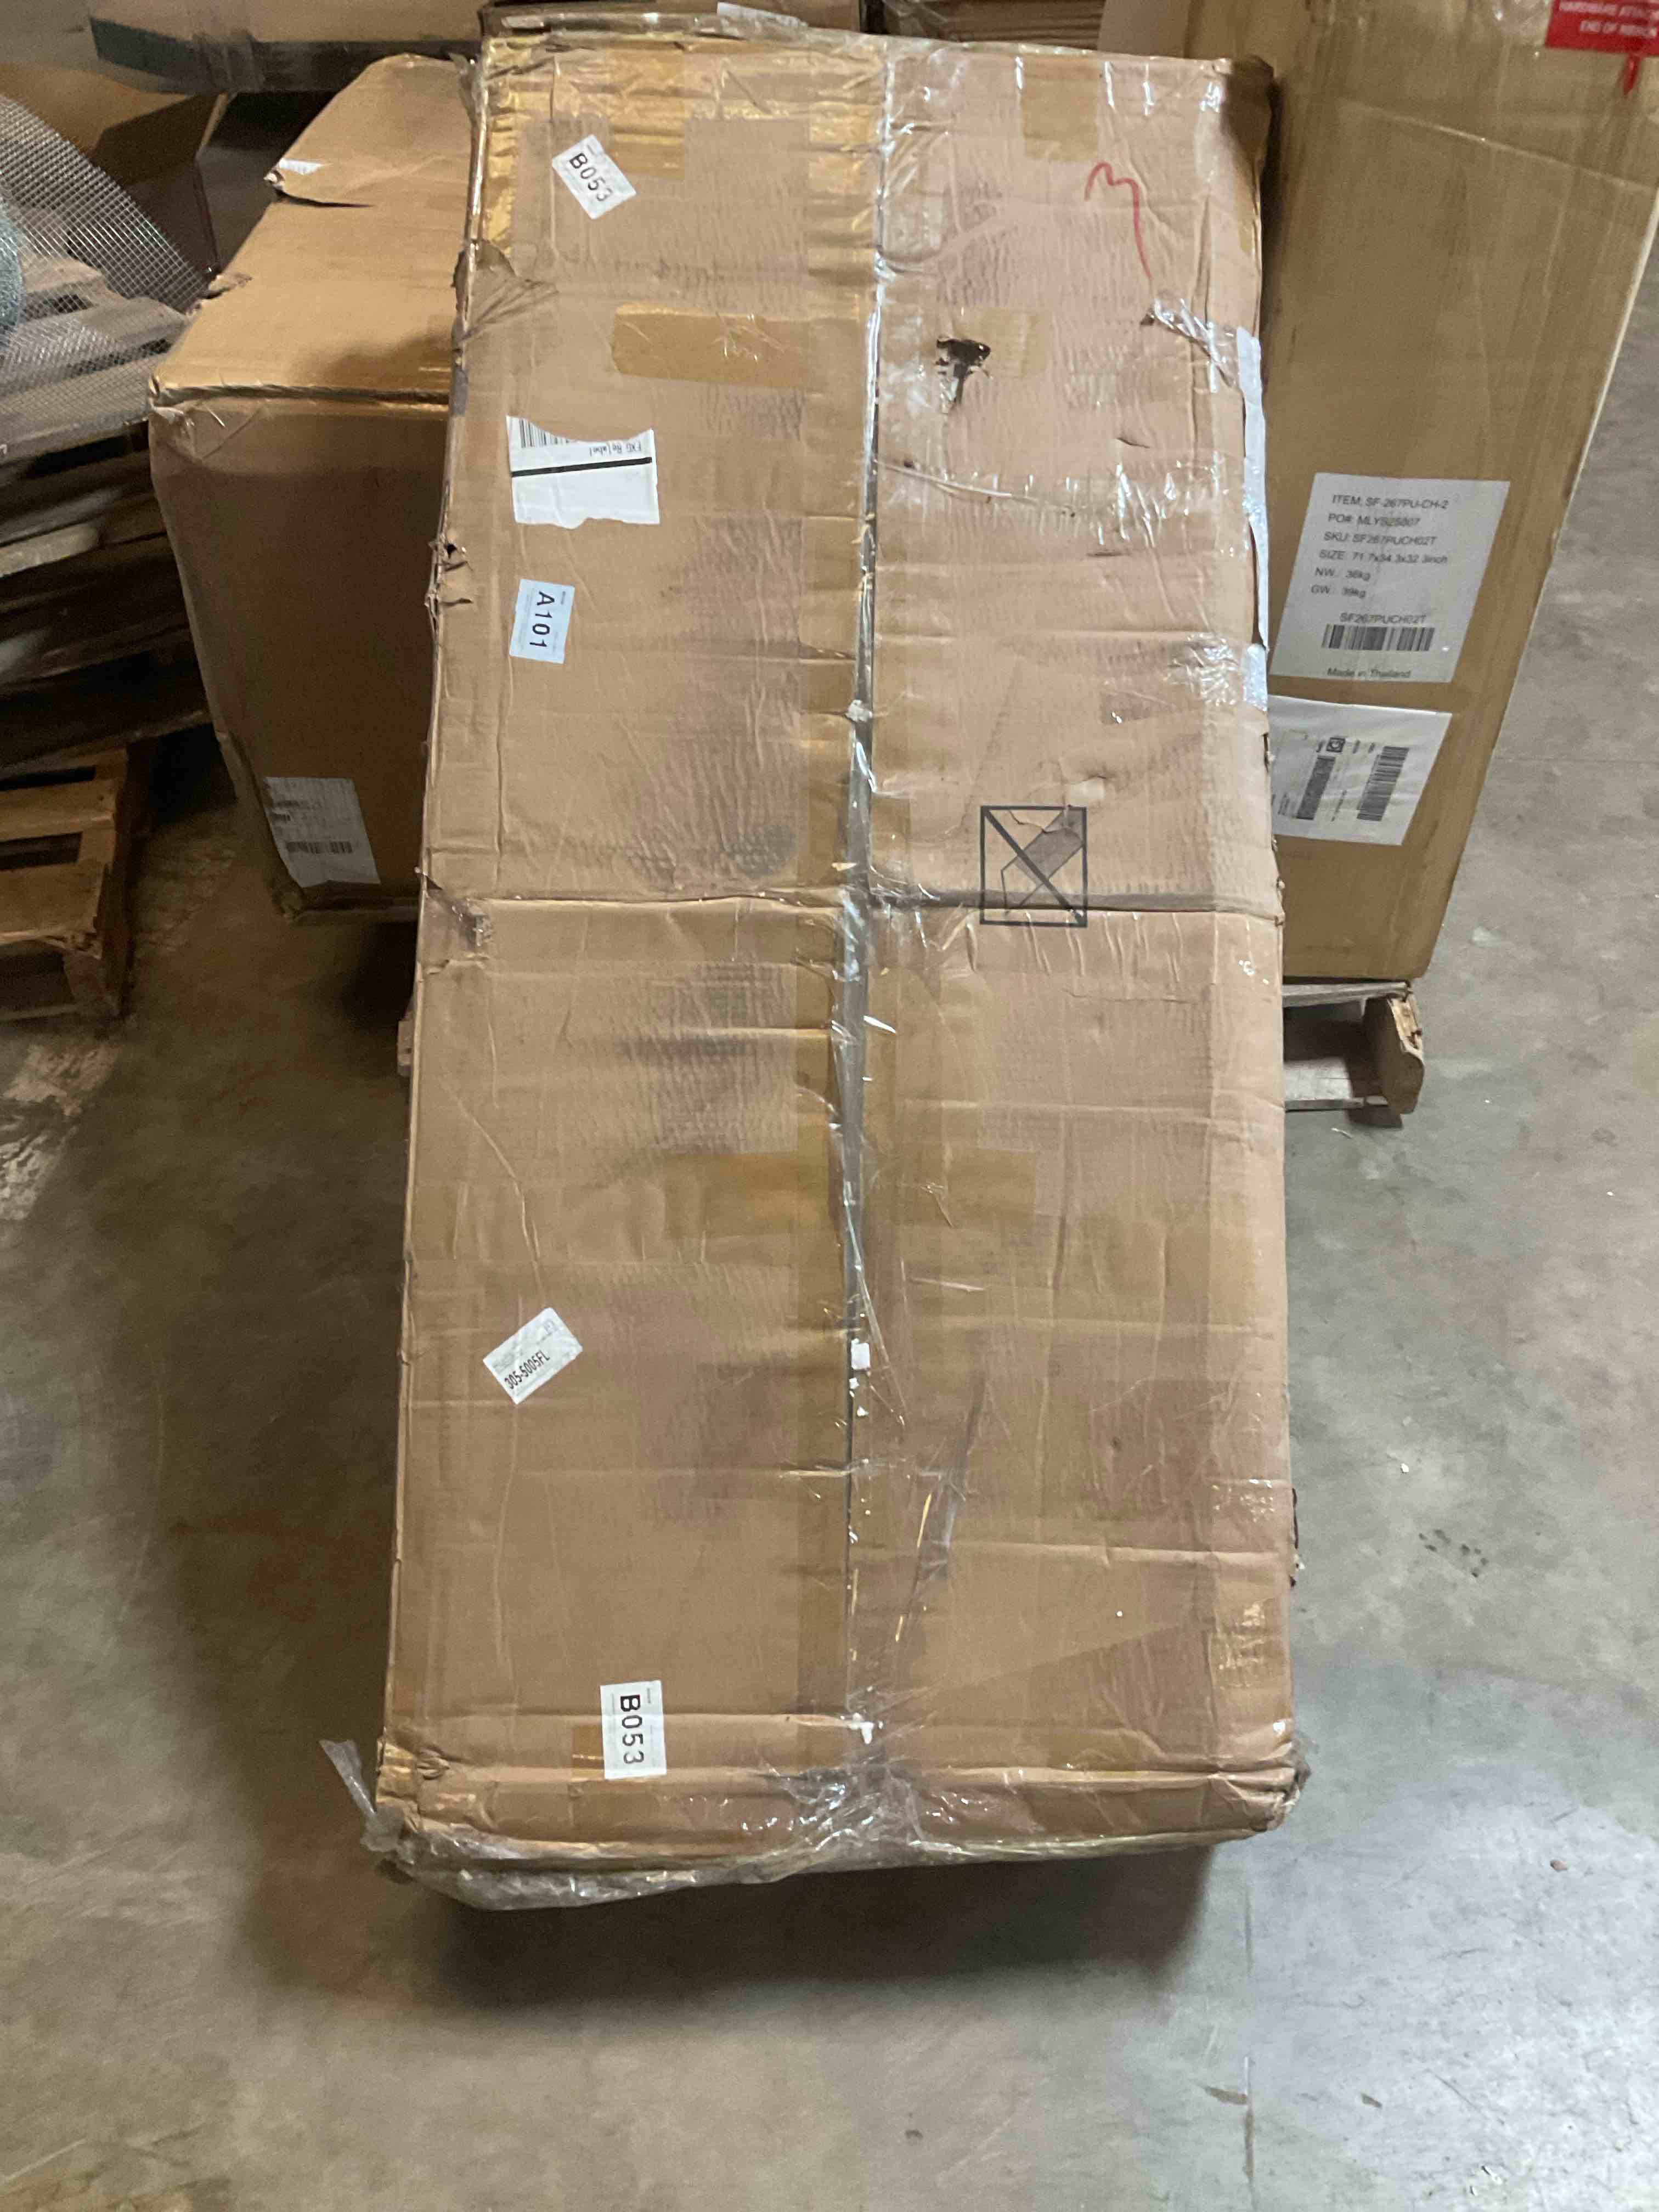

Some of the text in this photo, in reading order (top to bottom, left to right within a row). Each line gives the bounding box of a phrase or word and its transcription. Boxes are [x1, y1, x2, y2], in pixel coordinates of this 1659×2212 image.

[569, 153, 613, 201] B053
[589, 443, 623, 457] Relabel
[529, 591, 555, 647] A101
[1327, 668, 1355, 677] Made
[1370, 668, 1410, 679] Thailand
[620, 1694, 645, 1764] B053
